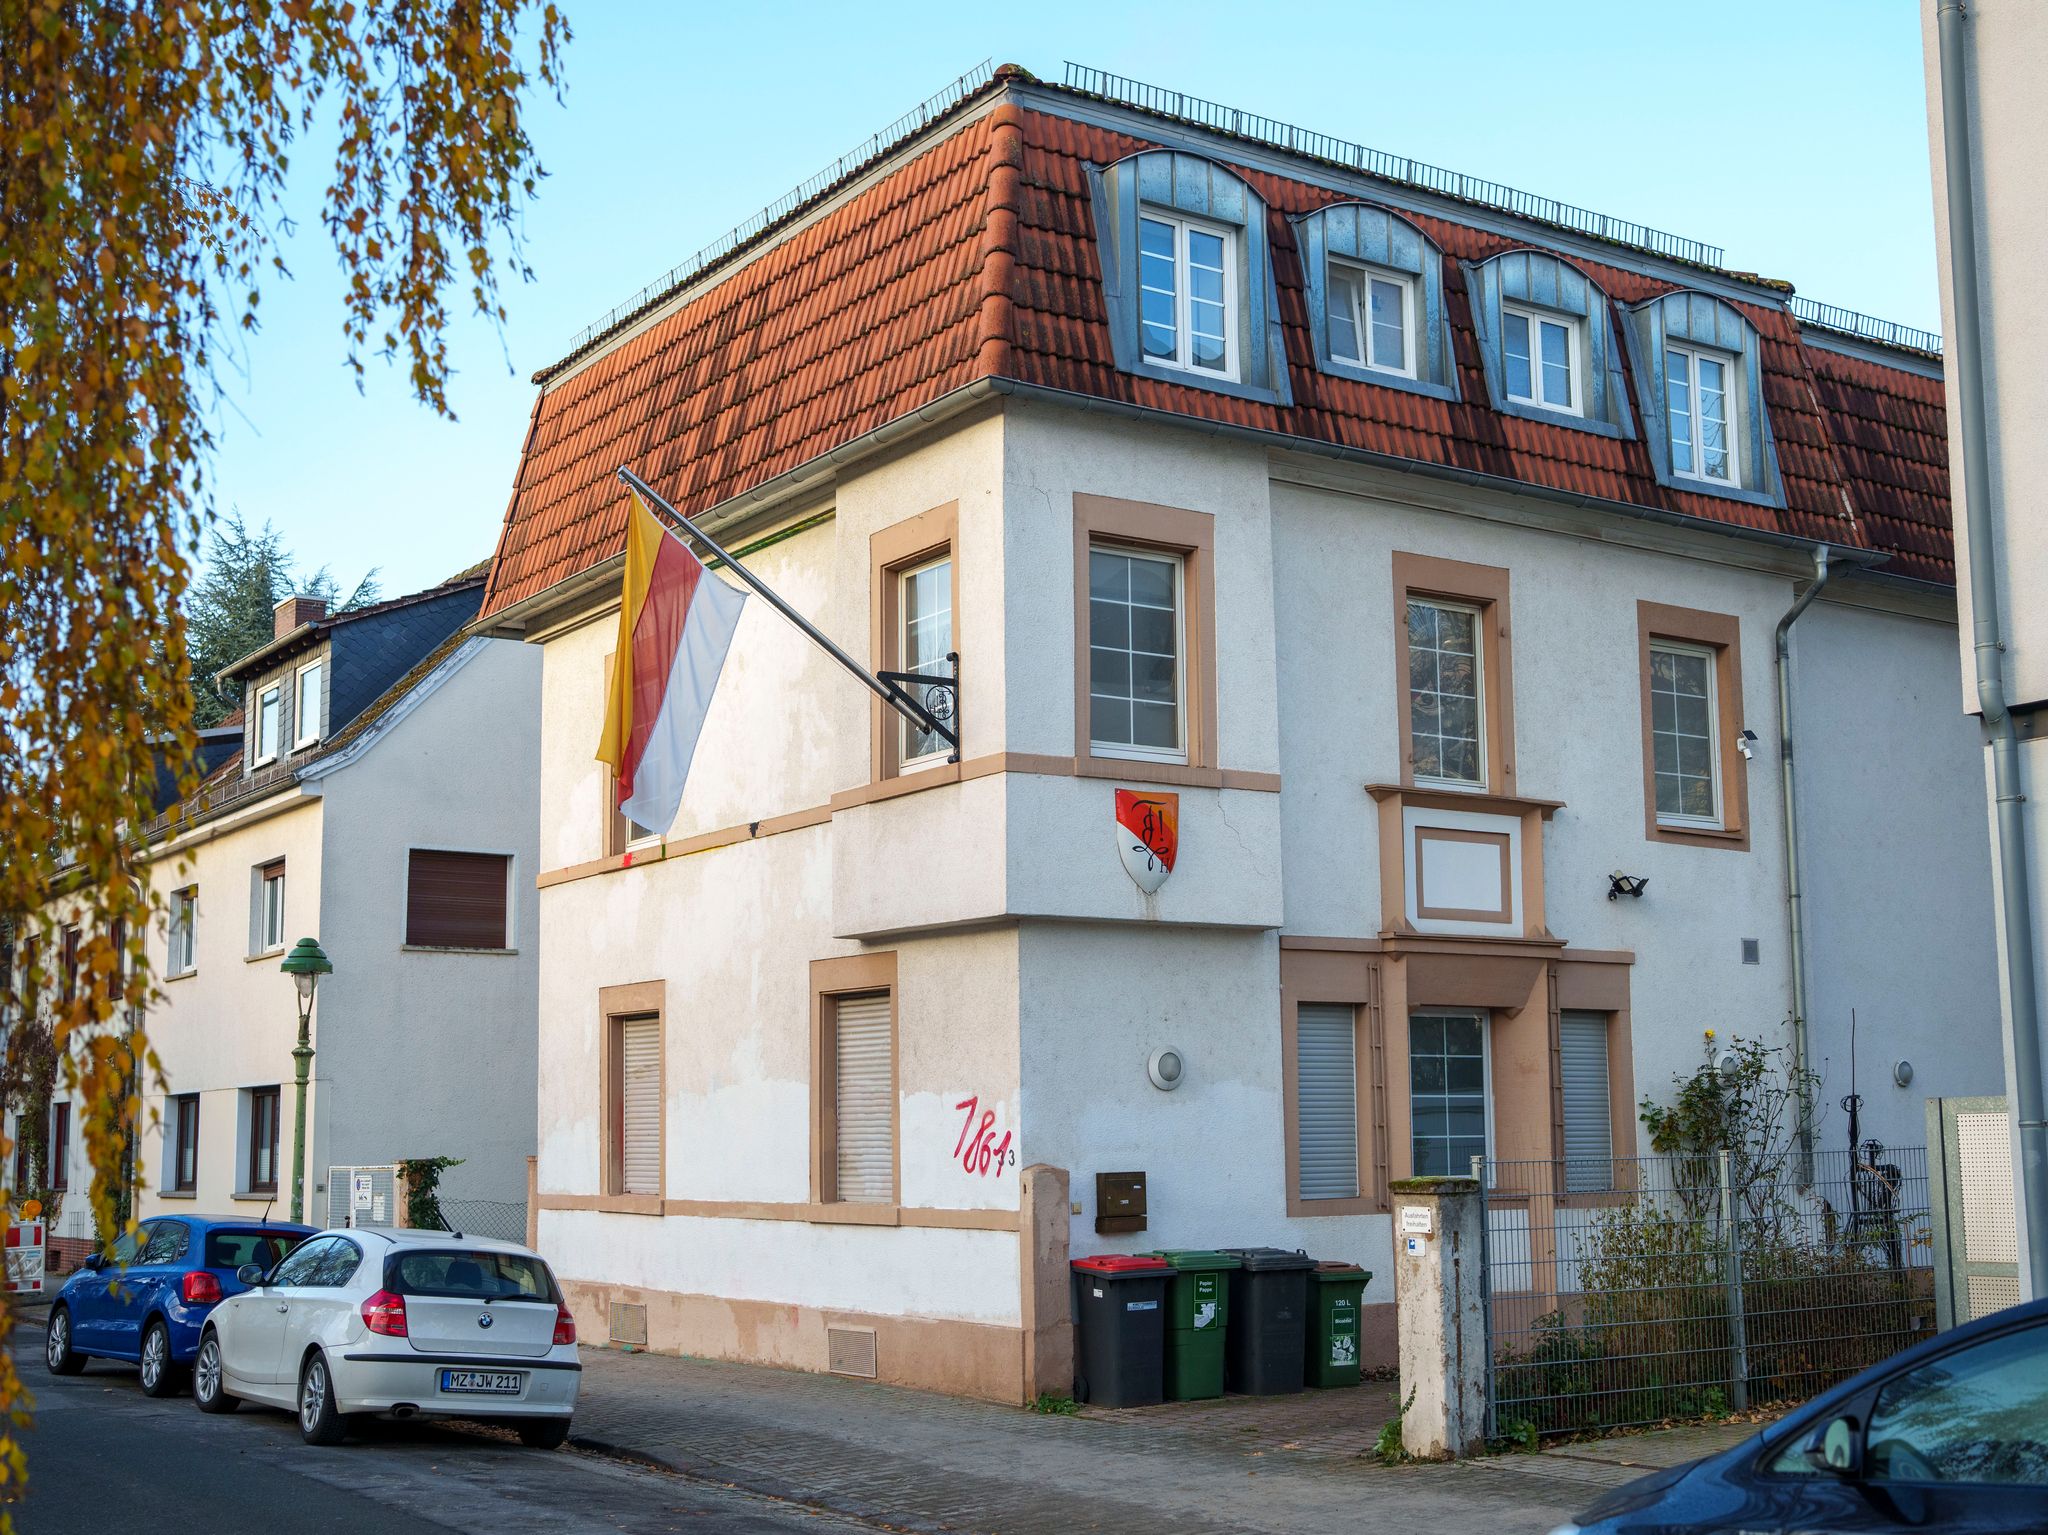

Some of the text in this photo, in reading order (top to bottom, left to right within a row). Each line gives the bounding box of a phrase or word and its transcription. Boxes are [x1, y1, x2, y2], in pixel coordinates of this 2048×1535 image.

[450, 1373, 518, 1390] MZ JW 211
